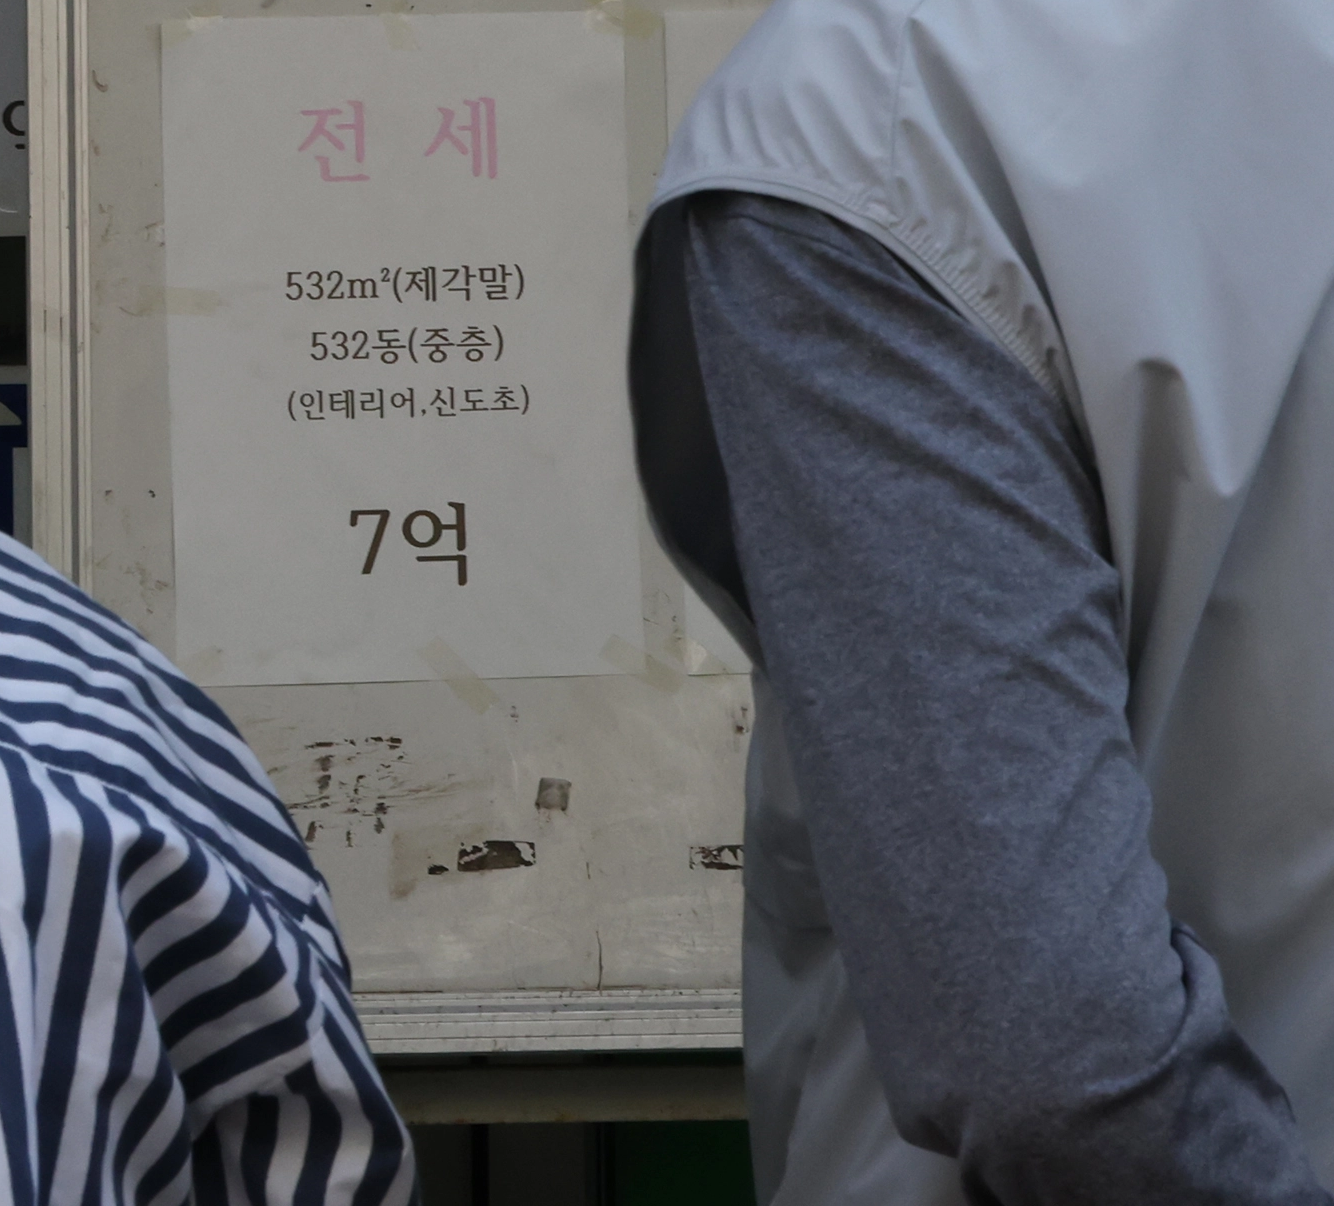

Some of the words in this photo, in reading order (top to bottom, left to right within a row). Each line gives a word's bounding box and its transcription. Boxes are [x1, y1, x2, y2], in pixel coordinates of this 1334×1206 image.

[298, 99, 371, 183] 전
[424, 96, 499, 180] 세
[309, 324, 505, 365] 532동(중층)
[348, 501, 469, 587] 7억
